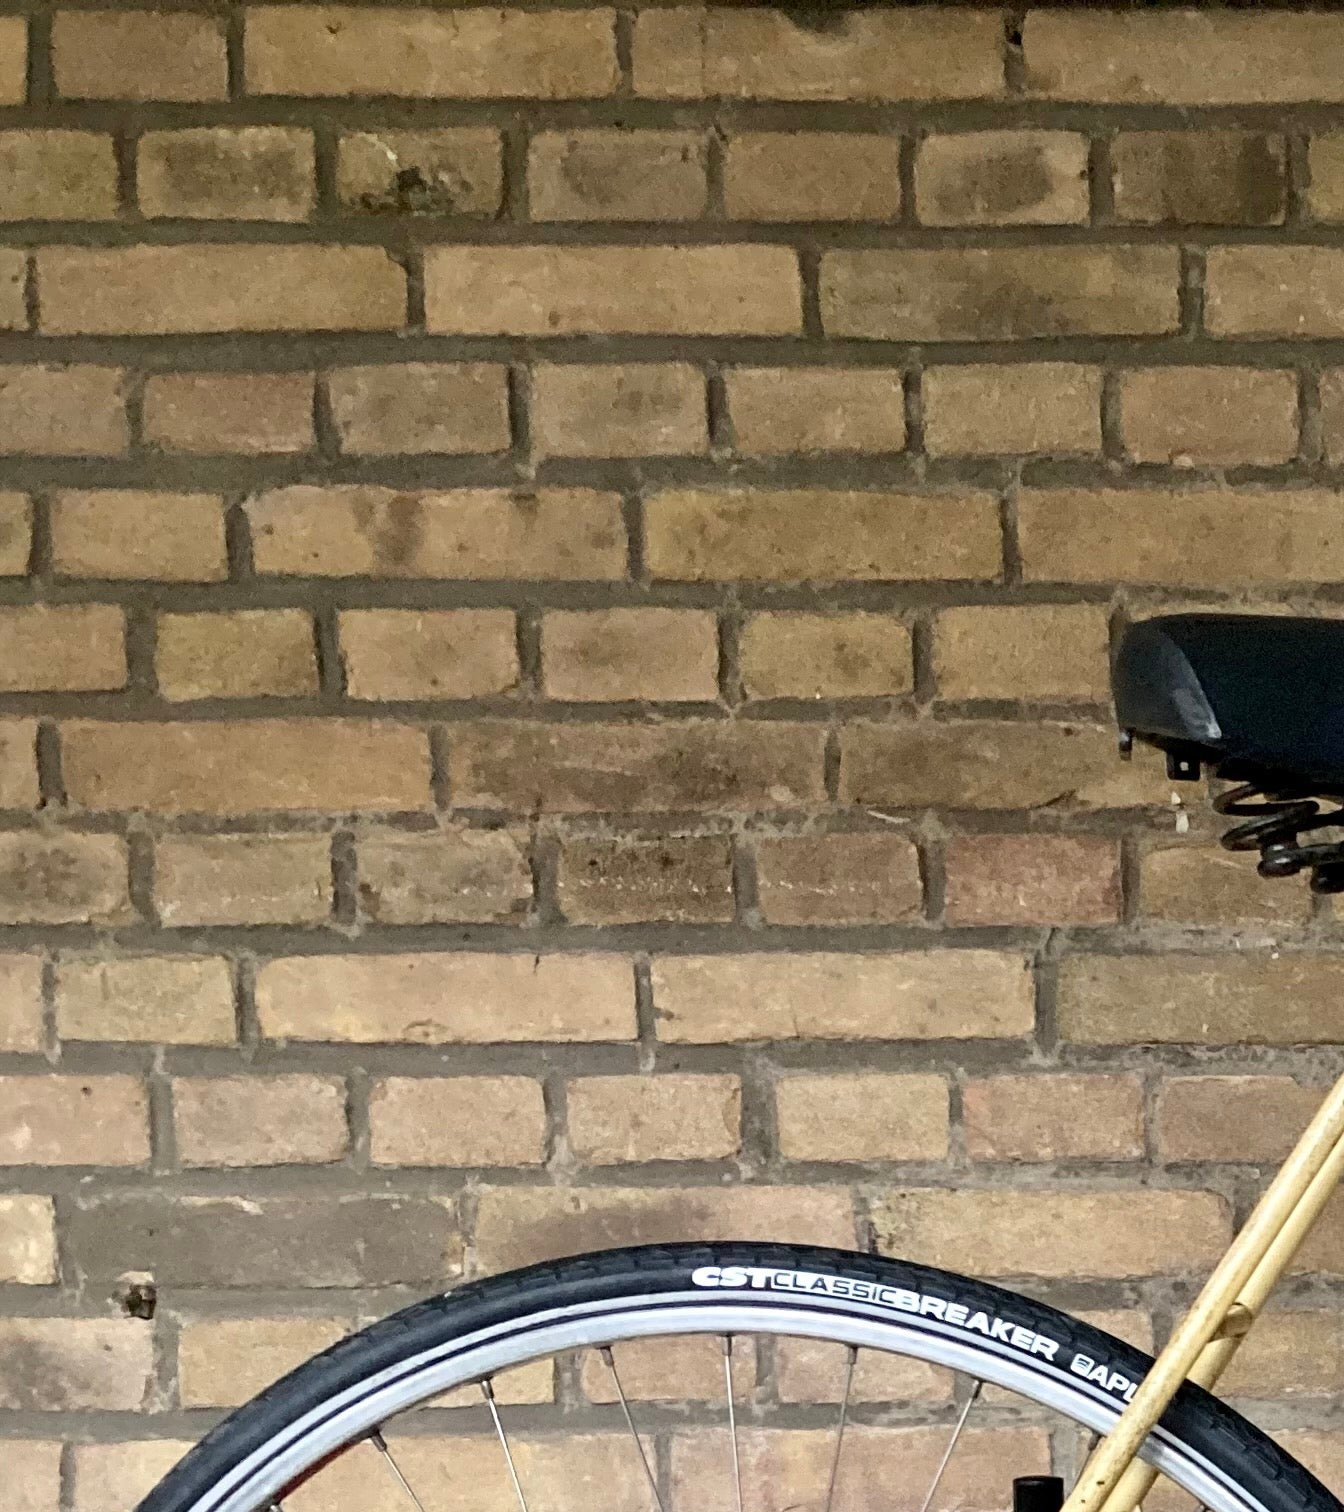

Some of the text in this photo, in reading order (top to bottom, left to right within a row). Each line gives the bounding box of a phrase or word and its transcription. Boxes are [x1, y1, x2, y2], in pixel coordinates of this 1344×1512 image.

[692, 1266, 771, 1288] CST
[772, 1271, 896, 1305] CLASSIC
[896, 1290, 1060, 1362] BREAKER
